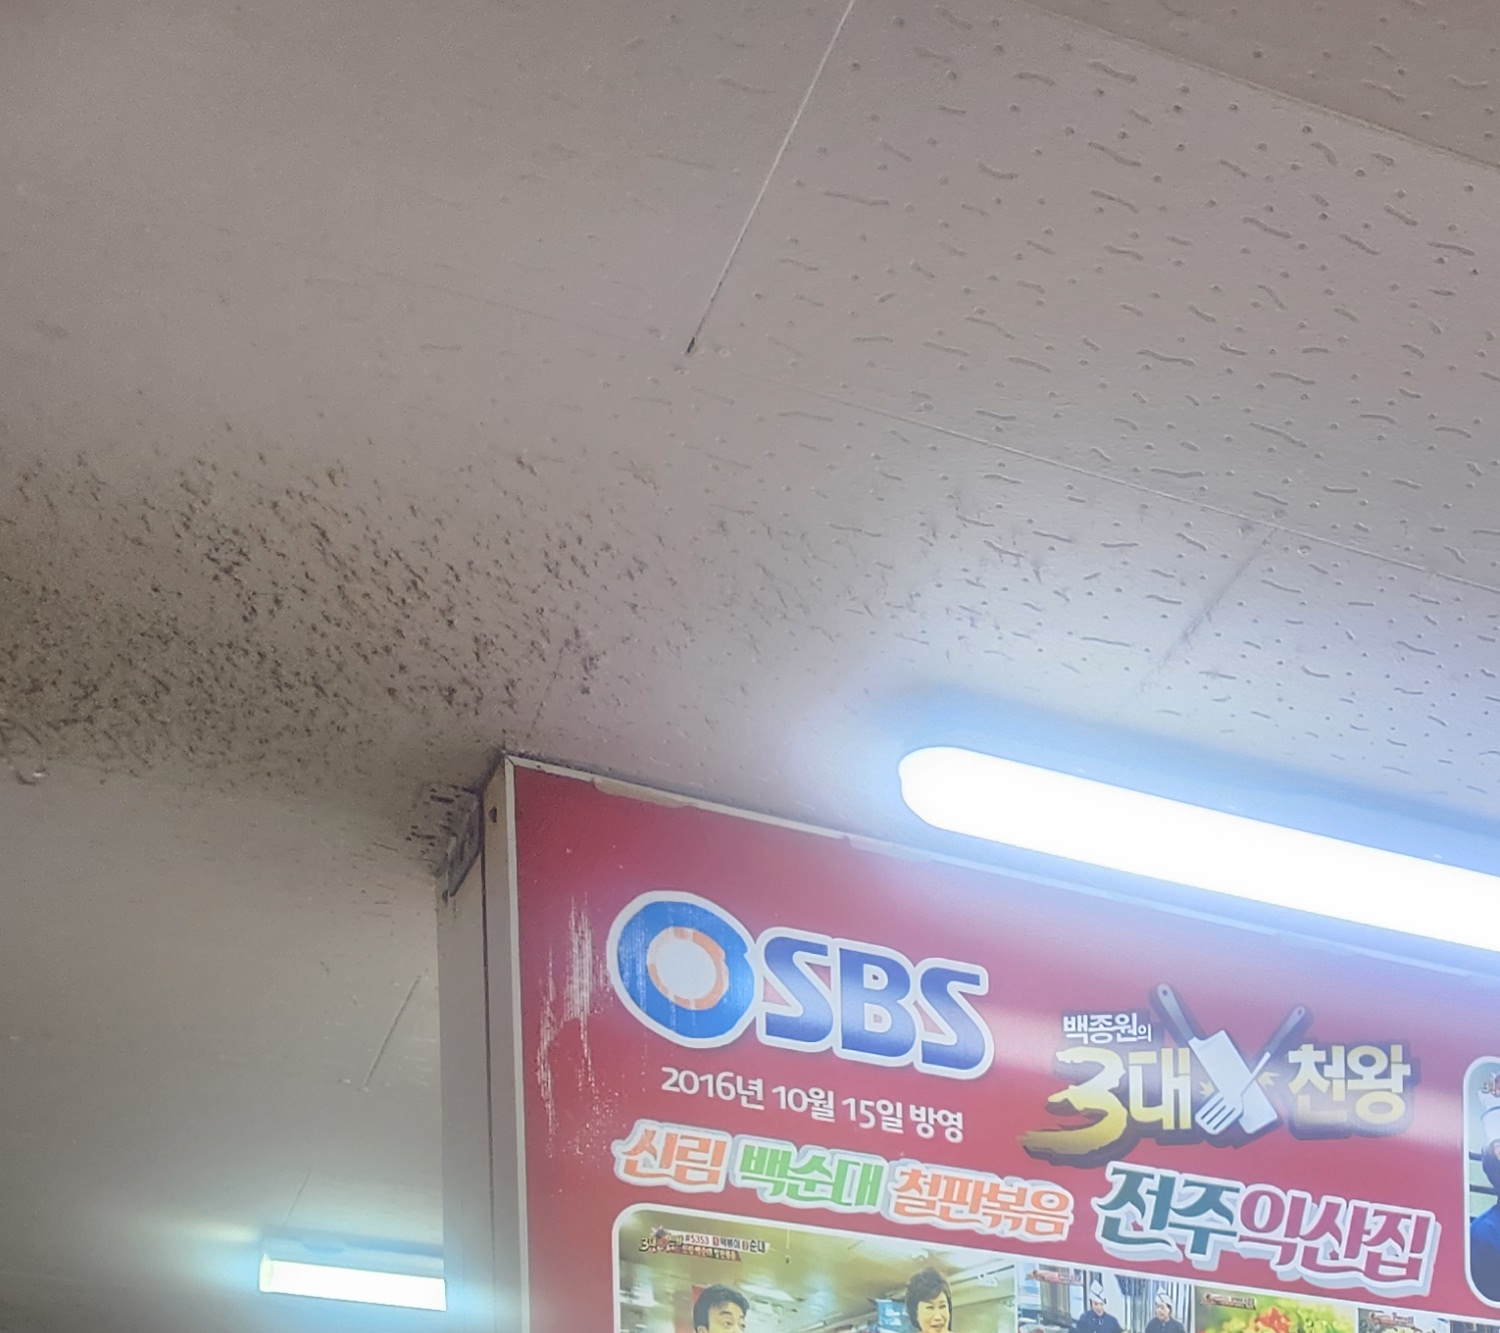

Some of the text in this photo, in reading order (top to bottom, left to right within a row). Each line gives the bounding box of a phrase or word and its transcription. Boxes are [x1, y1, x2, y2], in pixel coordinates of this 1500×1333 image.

[763, 935, 990, 1073] SBS
[1062, 1011, 1152, 1043] 백종원의
[660, 1065, 964, 1145] 2016년 10월 15일 방영
[1023, 1042, 1411, 1158] 3대 천왕
[619, 1128, 1074, 1237] 신림 백순대 철판볶음
[1097, 1163, 1429, 1281] 전주익산집
